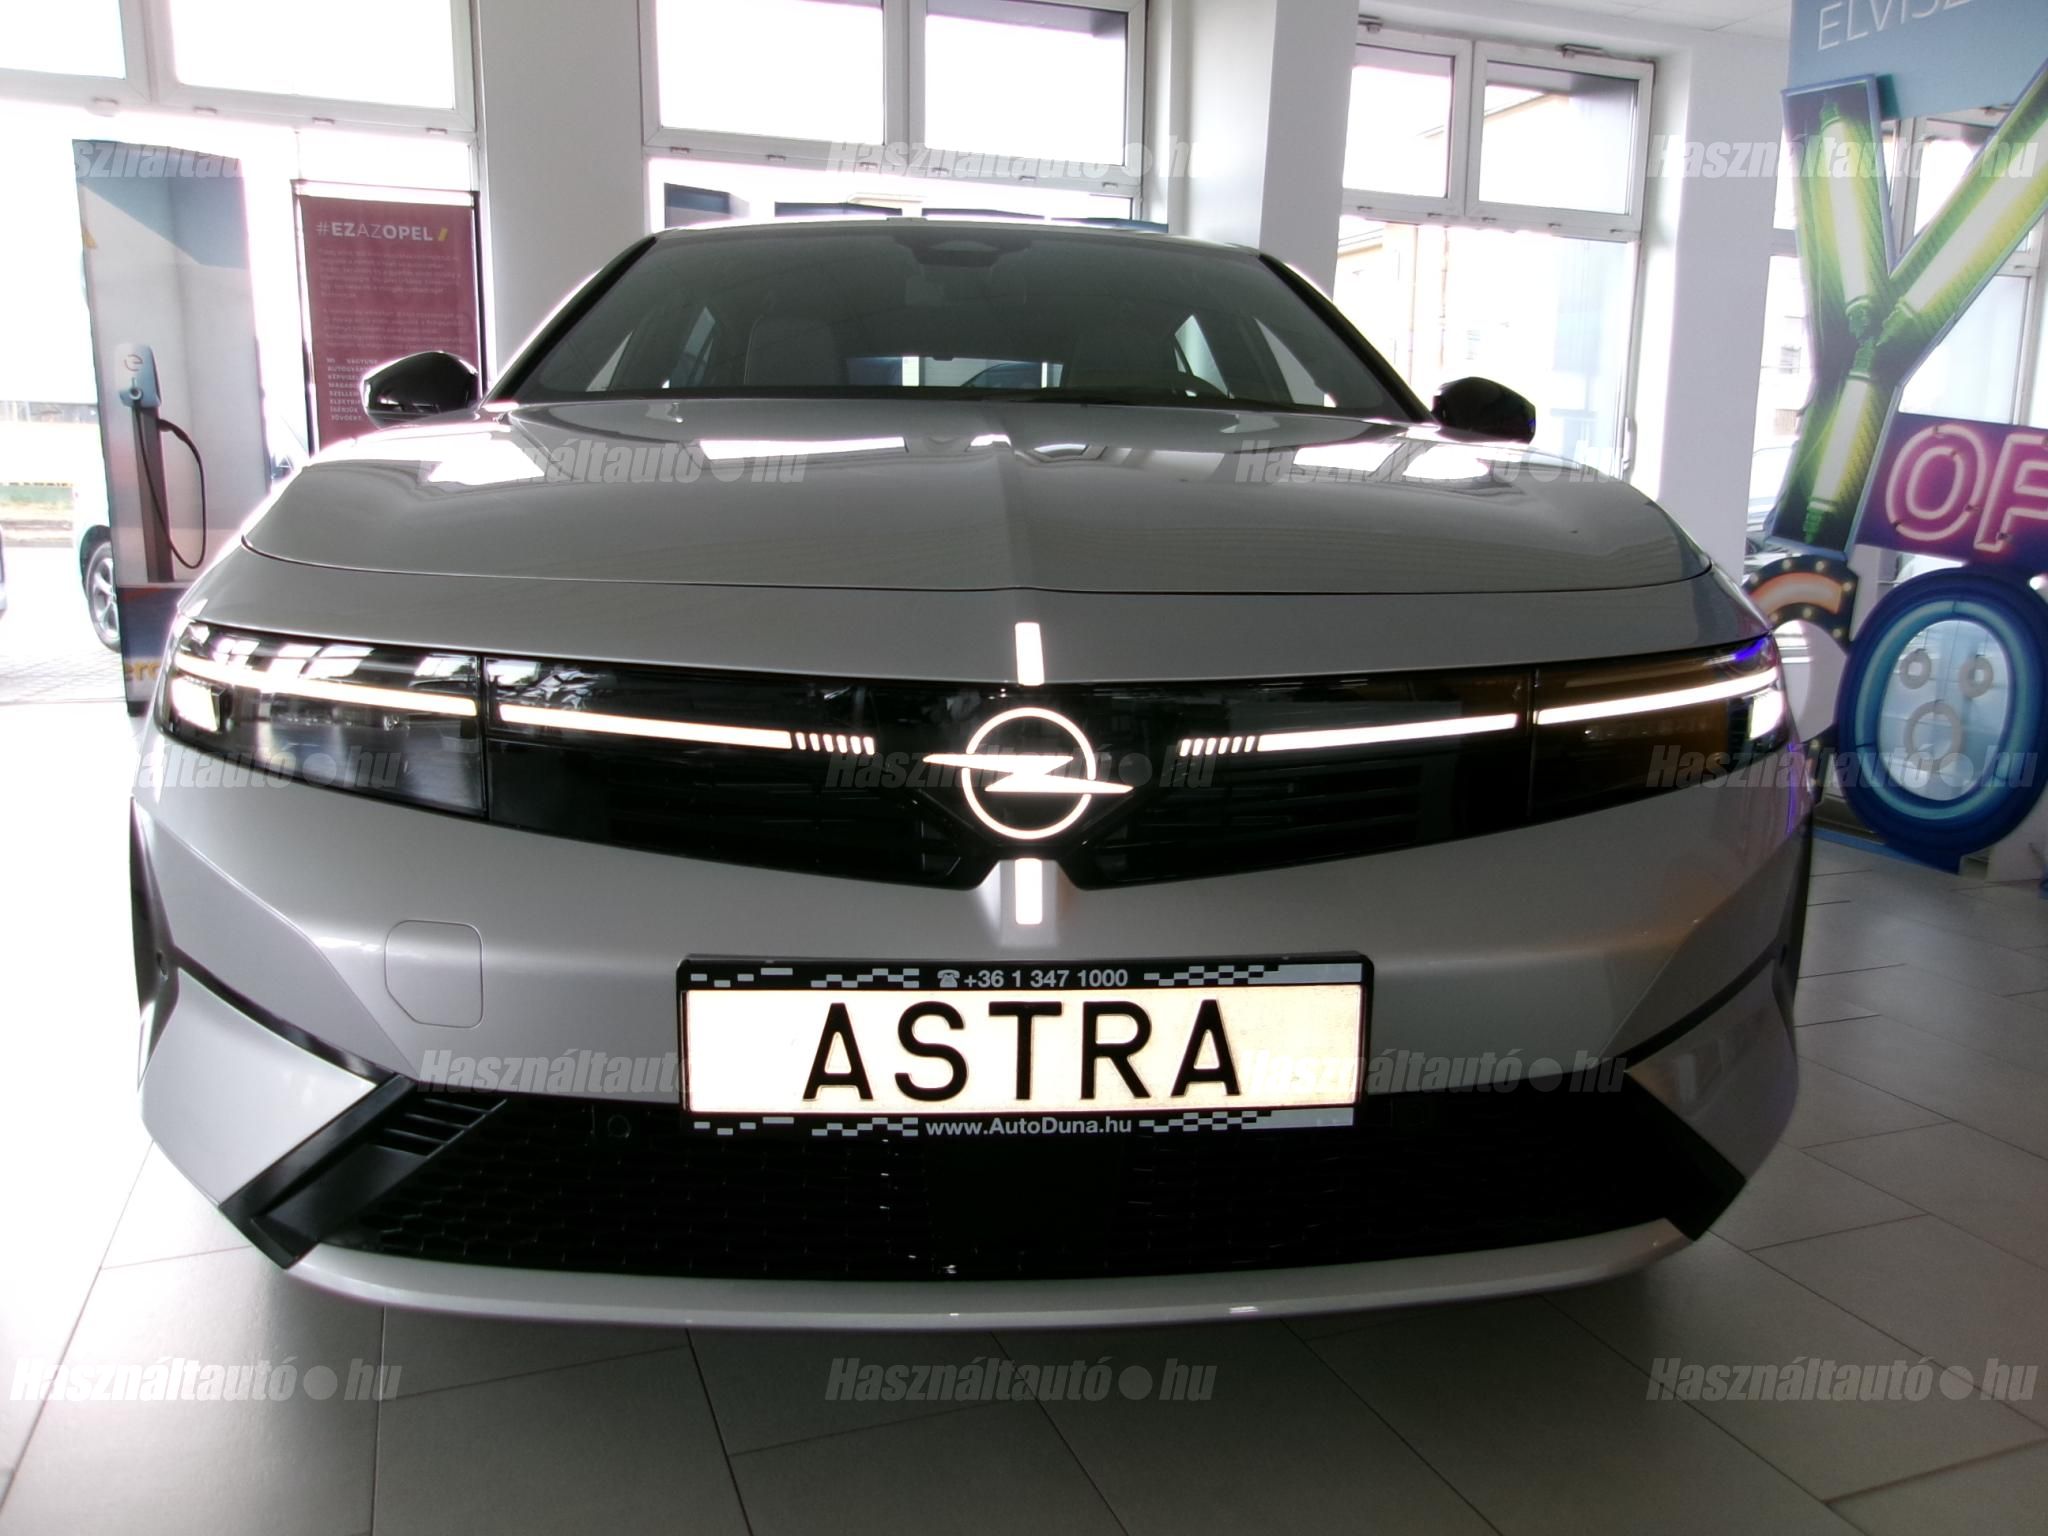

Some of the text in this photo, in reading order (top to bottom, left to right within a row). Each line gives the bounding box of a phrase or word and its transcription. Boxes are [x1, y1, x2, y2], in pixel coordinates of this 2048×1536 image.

[1818, 0, 1972, 51] ELVI
[315, 221, 434, 241] #EZAZOPEL
[964, 968, 1129, 988] +36 1 347 1000
[802, 999, 1242, 1102] ASTRA
[926, 1116, 1133, 1136] www.AutoDuna.hu
